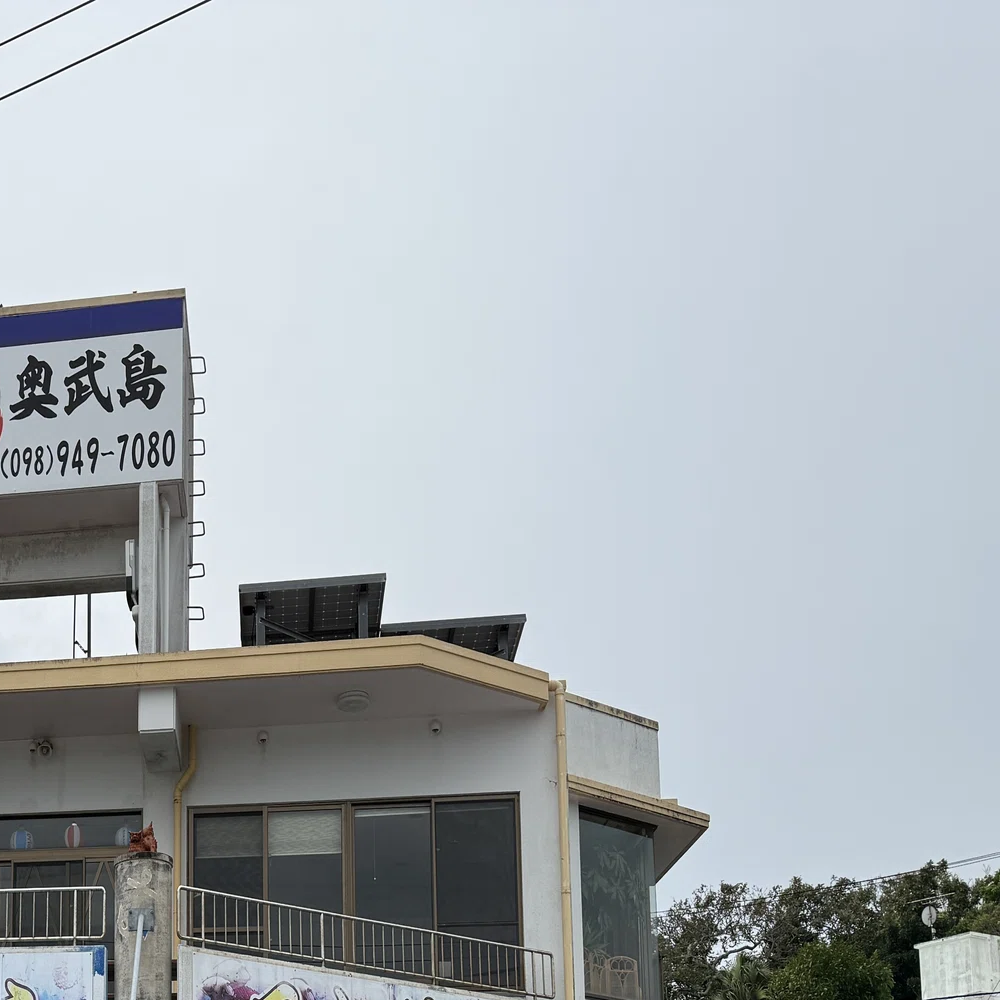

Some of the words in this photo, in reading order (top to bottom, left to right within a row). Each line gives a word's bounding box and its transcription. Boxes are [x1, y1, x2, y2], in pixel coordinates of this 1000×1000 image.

[8, 344, 168, 421] 奥武島
[0, 429, 176, 479] (098)949-7080
